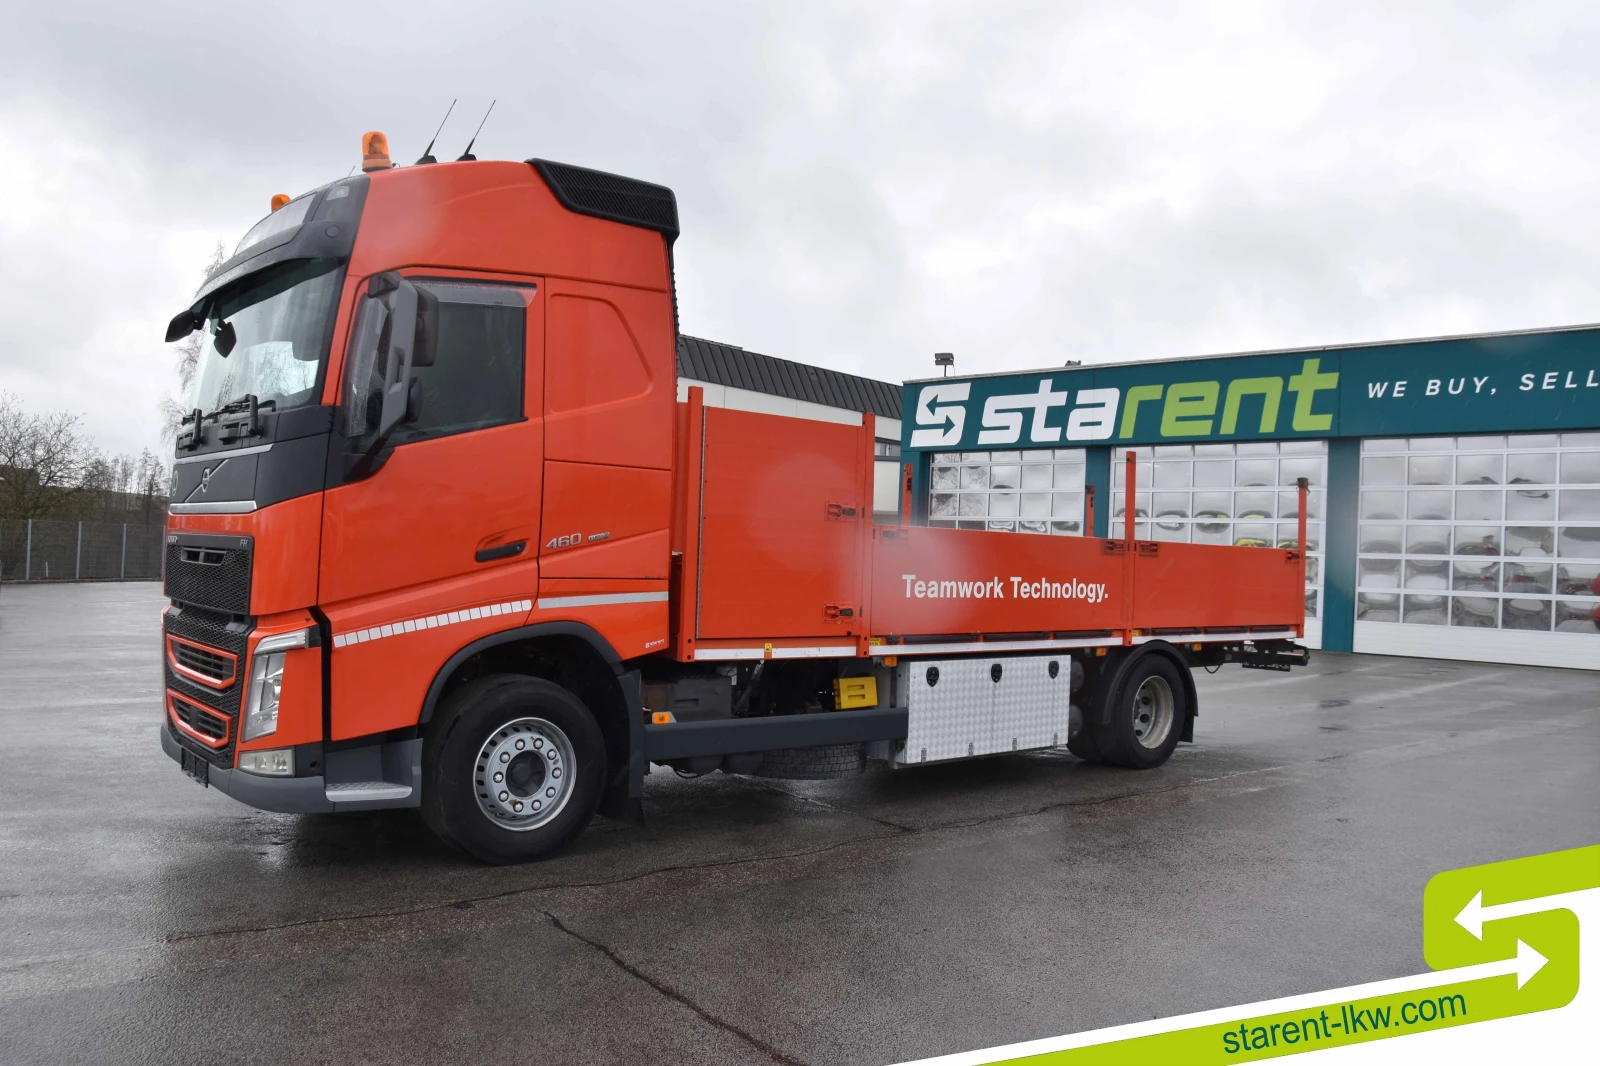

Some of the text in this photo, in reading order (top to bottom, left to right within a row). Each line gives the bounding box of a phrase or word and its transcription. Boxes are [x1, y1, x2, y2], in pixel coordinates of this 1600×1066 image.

[1368, 370, 1599, 399] WE BUY, SELL
[977, 358, 1340, 446] starent
[545, 532, 582, 549] 460
[902, 574, 1109, 604] Teamwork Technology.
